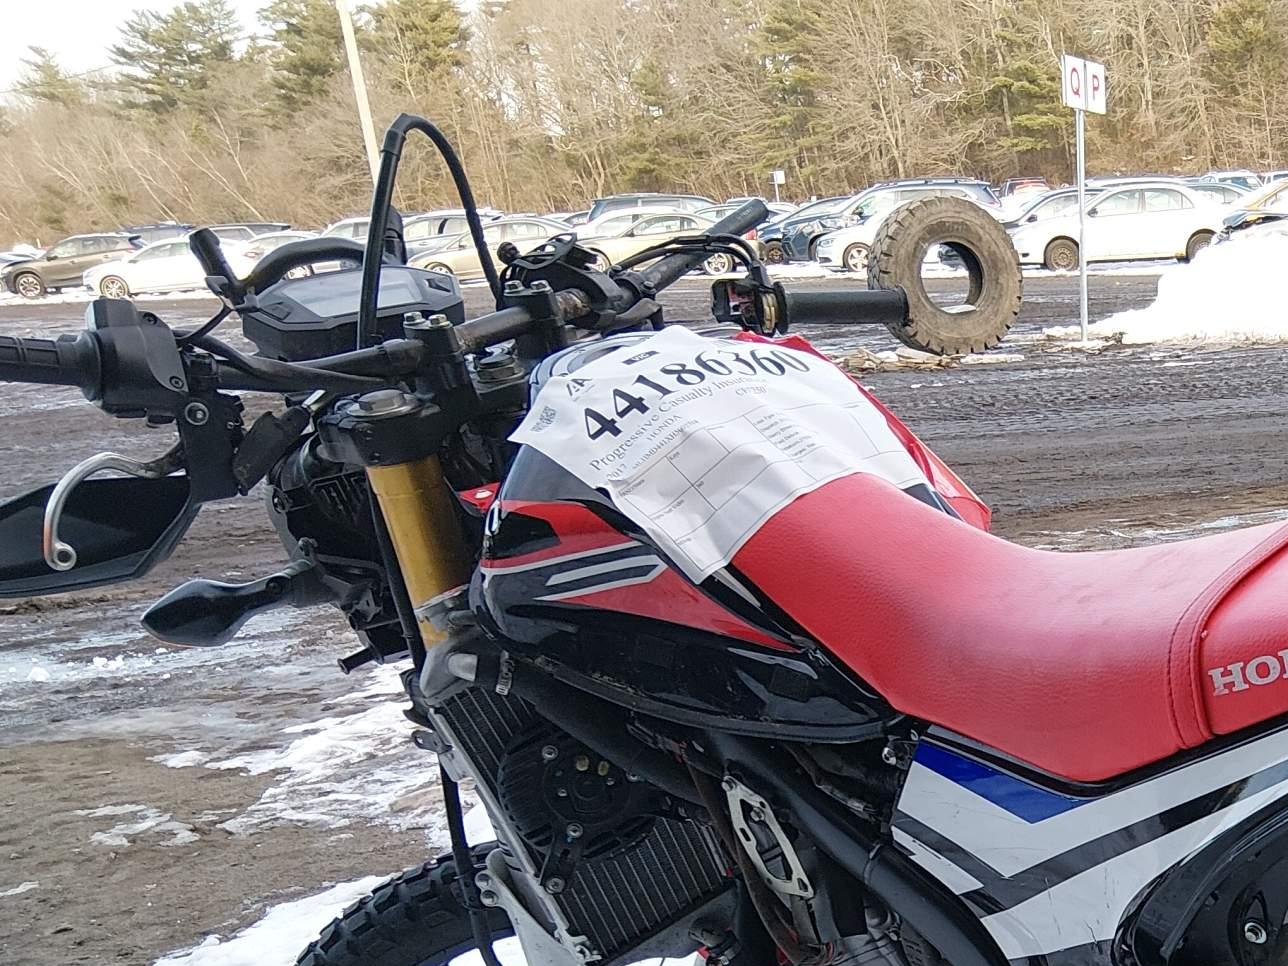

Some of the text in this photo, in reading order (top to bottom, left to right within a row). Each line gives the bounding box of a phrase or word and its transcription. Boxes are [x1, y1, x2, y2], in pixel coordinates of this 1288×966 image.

[1070, 67, 1081, 98] Q
[1092, 74, 1100, 101] P
[584, 350, 810, 440] 44186360
[589, 414, 660, 471] Progressive
[658, 381, 712, 412] Casualty
[647, 414, 682, 442] HONDA
